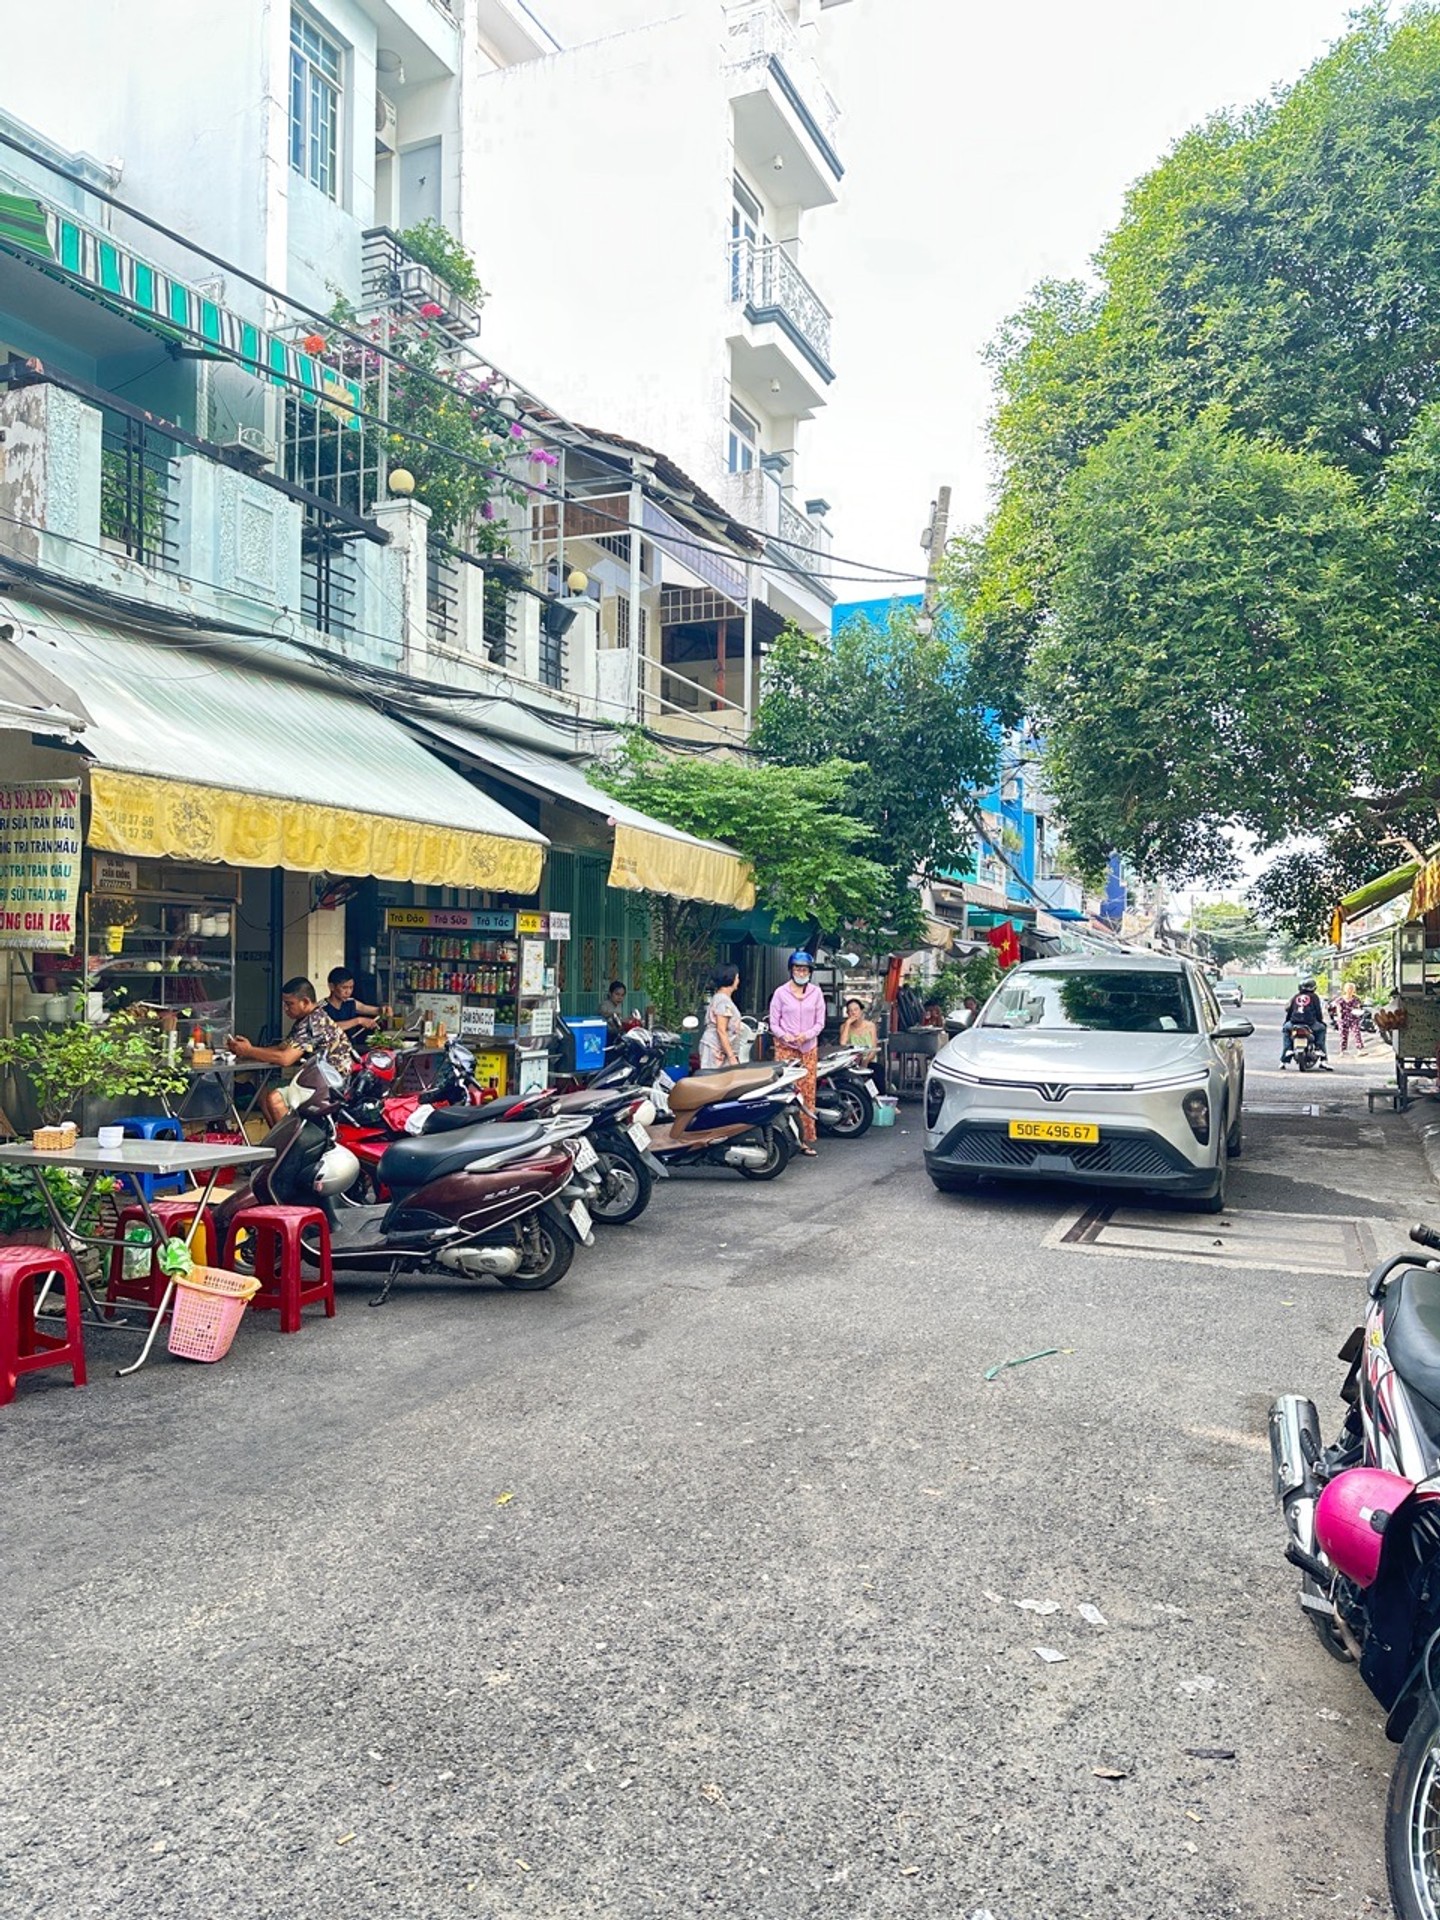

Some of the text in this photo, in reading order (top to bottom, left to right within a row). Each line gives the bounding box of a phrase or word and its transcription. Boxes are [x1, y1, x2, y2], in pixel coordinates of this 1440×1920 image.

[24, 908, 44, 931] GIÁ
[49, 912, 71, 932] 12K
[1016, 1123, 1091, 1139] 50E-496.67
